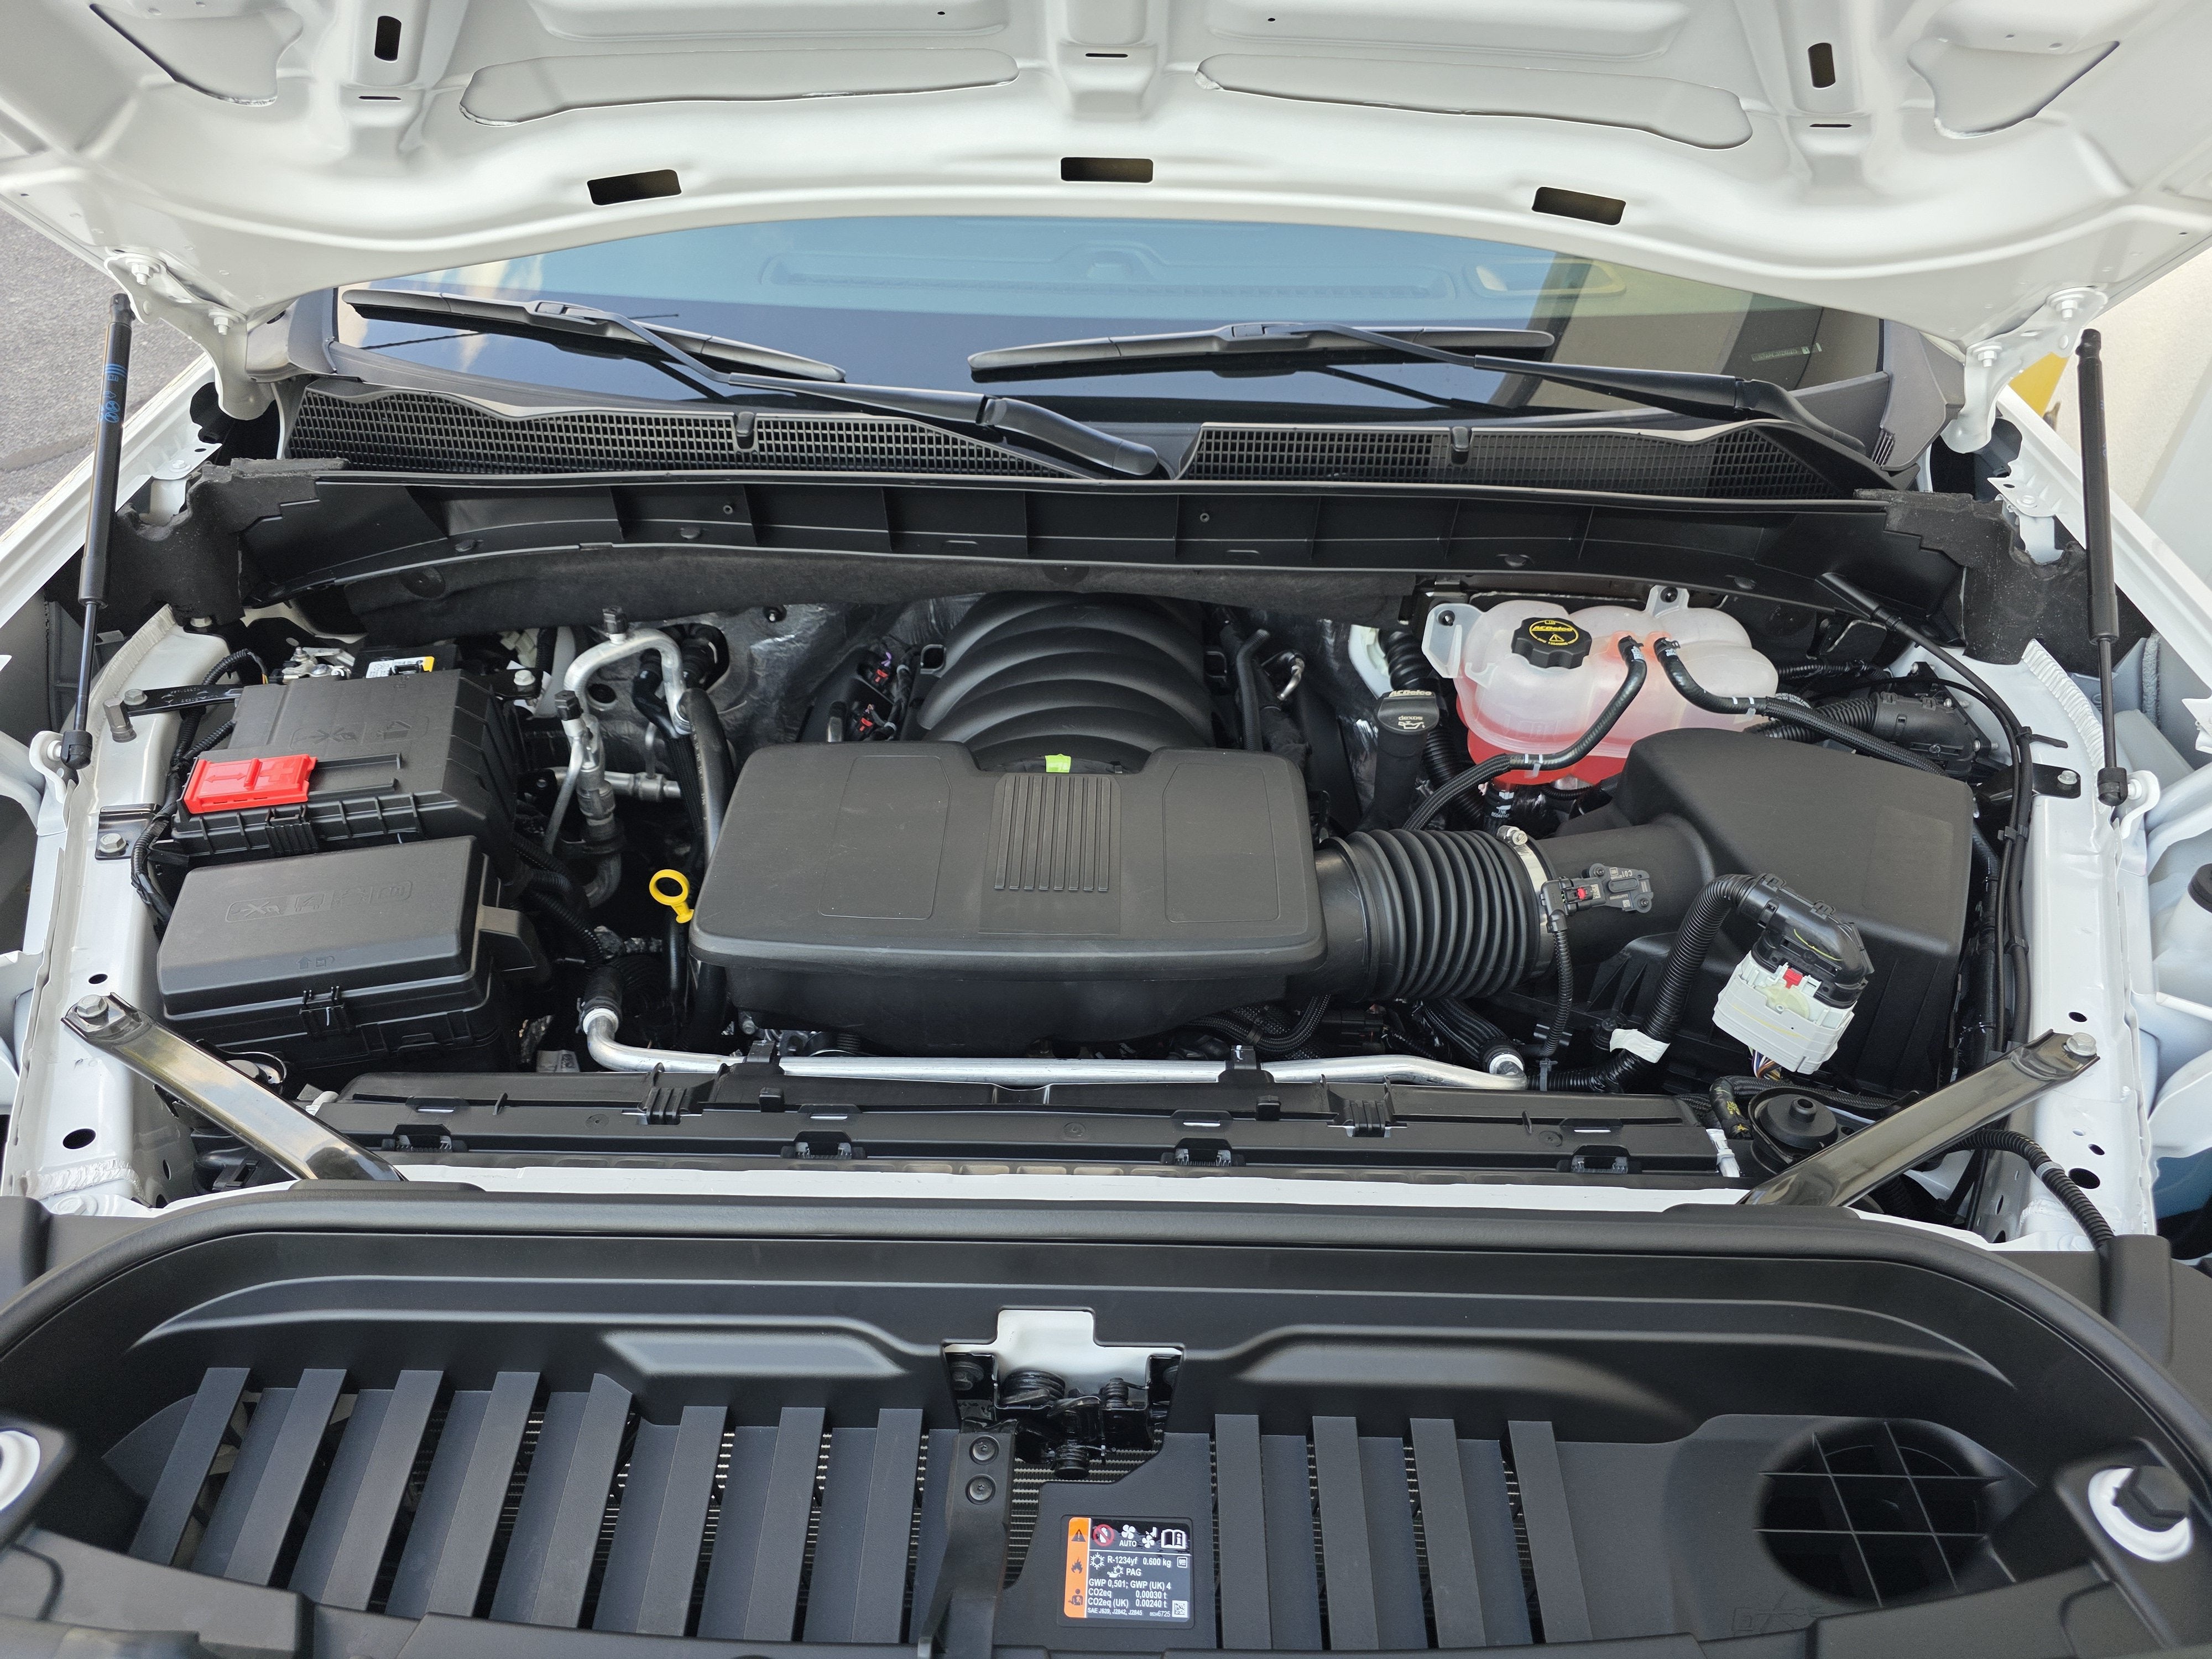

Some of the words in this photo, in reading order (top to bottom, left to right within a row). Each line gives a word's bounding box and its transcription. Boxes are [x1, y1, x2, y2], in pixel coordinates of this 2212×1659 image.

[1107, 1556, 1138, 1566] R-1234yf
[1162, 1558, 1171, 1568] kg
[1088, 1578, 1106, 1587] GWP
[1108, 1579, 1129, 1589] 0,501;
[1130, 1580, 1148, 1589] GWP
[1149, 1581, 1165, 1591] (UK)
[1088, 1588, 1112, 1598] CO2eq
[1135, 1590, 1162, 1599] 0,00030
[1088, 1598, 1112, 1608] CO2eq
[1113, 1599, 1129, 1609] (UK)
[1135, 1599, 1162, 1608] 0.00240
